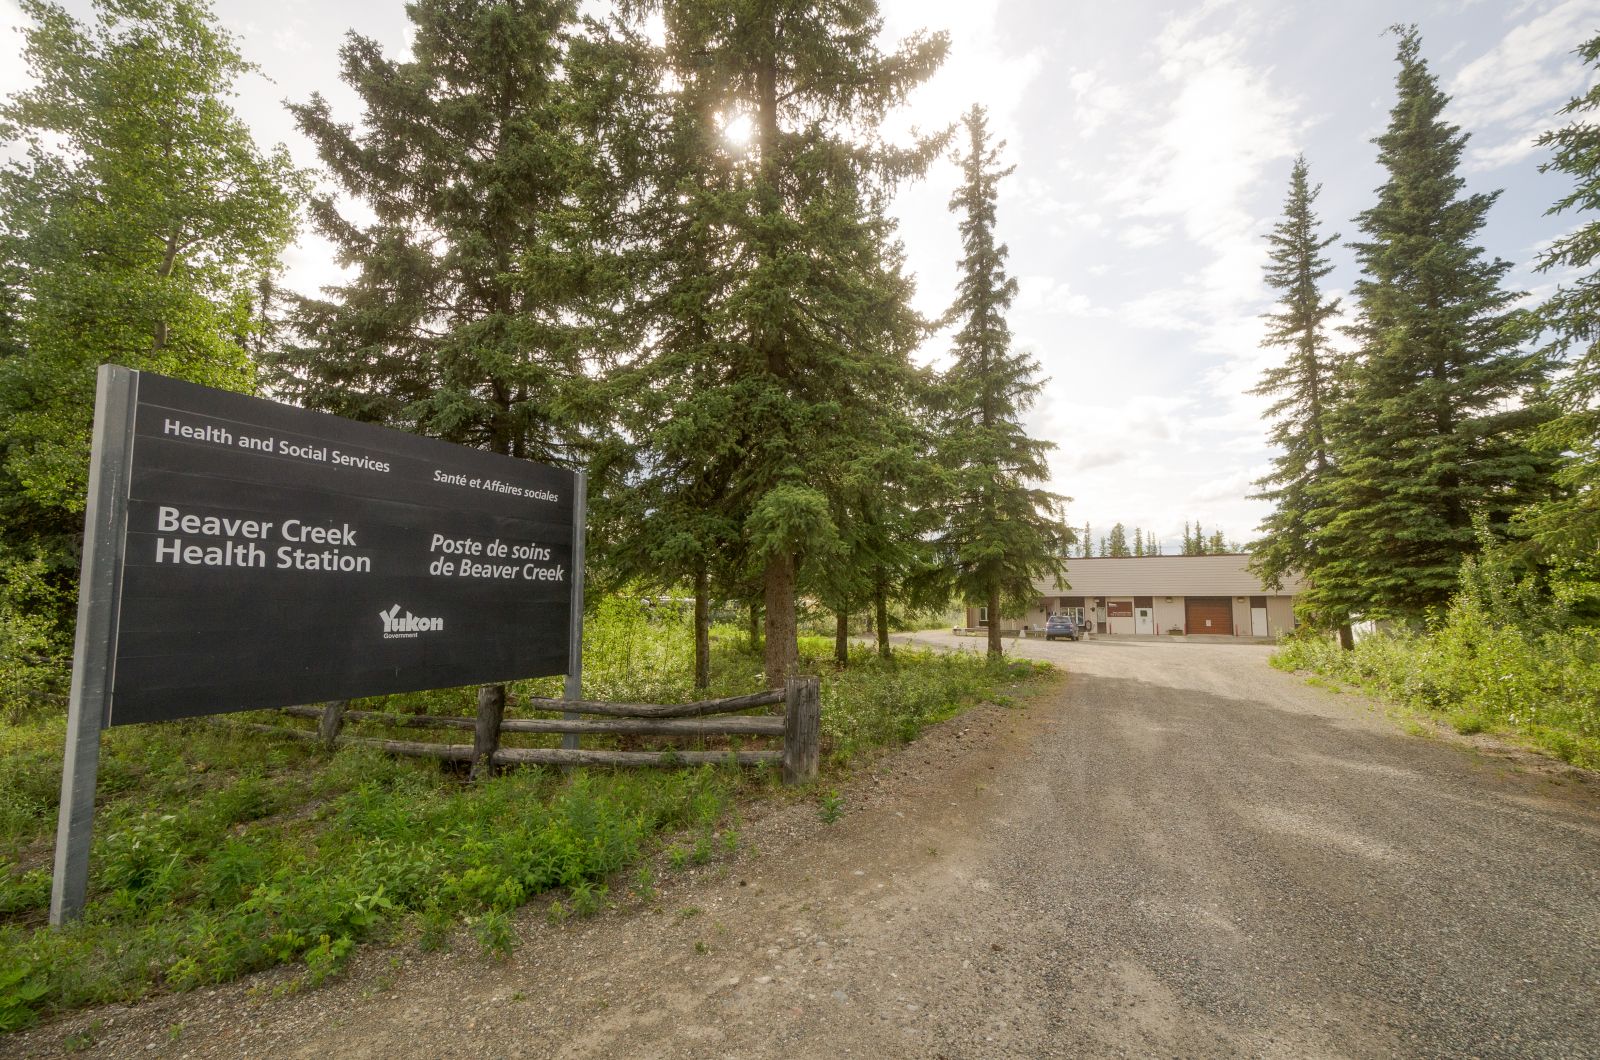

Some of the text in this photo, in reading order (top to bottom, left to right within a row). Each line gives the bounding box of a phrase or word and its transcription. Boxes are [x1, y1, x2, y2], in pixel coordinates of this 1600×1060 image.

[163, 418, 391, 473] Health and Social Services
[433, 469, 559, 503] Santé et Affaires sociales
[157, 505, 357, 547] Beaver Creek
[155, 537, 371, 573] Health Station
[430, 533, 551, 561] Poste de soins
[430, 555, 565, 582] de Beaver Creek
[379, 604, 444, 632] Yukon
